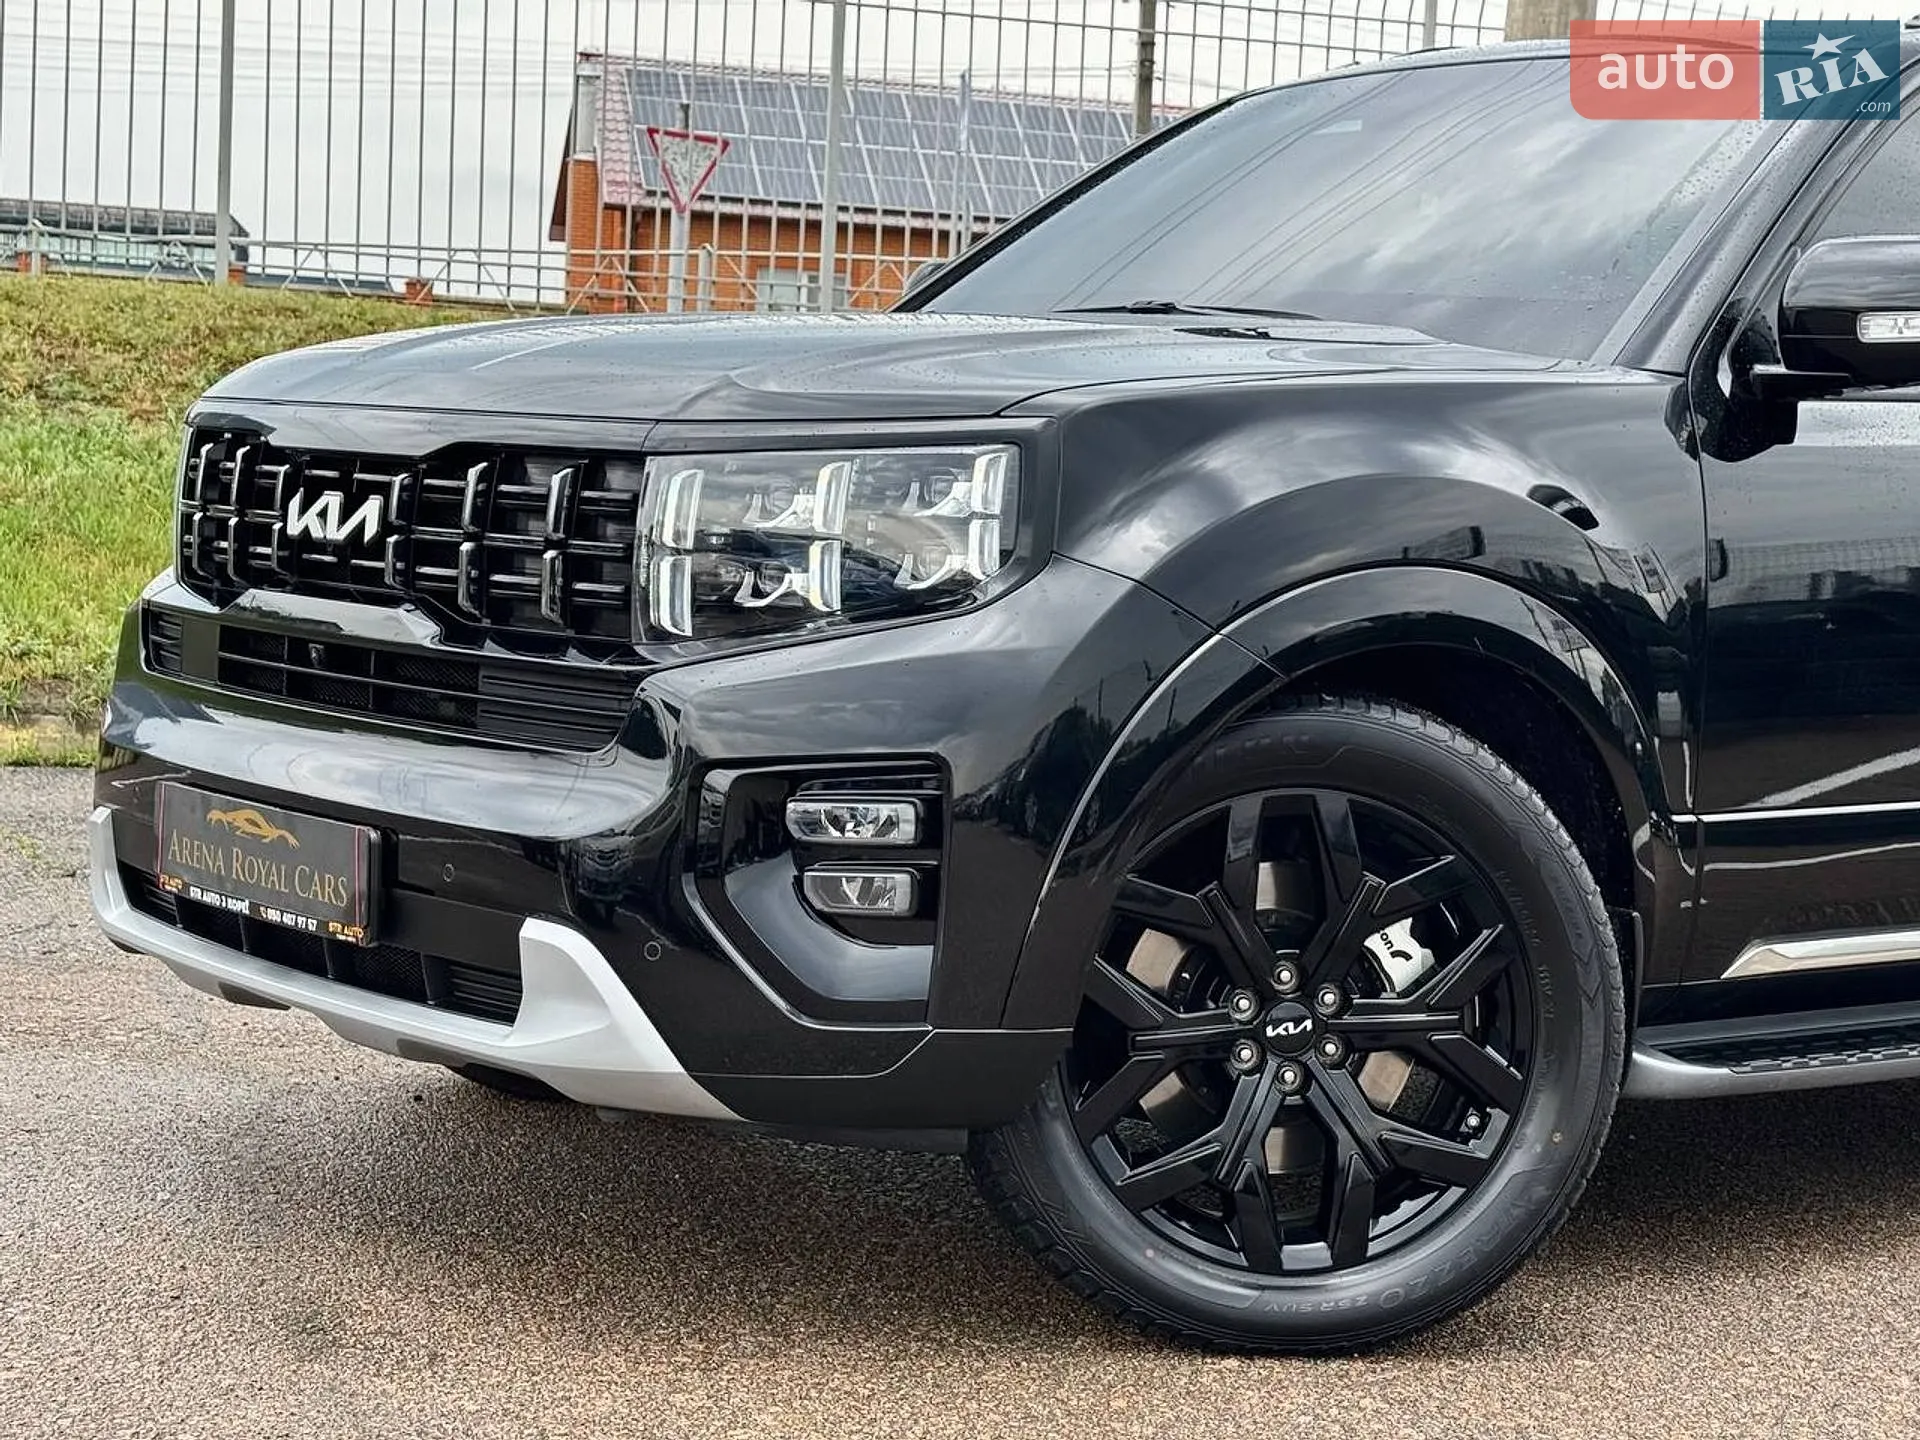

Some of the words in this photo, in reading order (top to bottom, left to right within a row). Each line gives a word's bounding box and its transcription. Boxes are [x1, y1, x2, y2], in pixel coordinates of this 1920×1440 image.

[286, 487, 384, 547] KIA
[167, 828, 226, 877] ARENA
[232, 846, 289, 893] ROYAL
[294, 864, 348, 908] CARS
[1265, 1018, 1313, 1038] KIA
